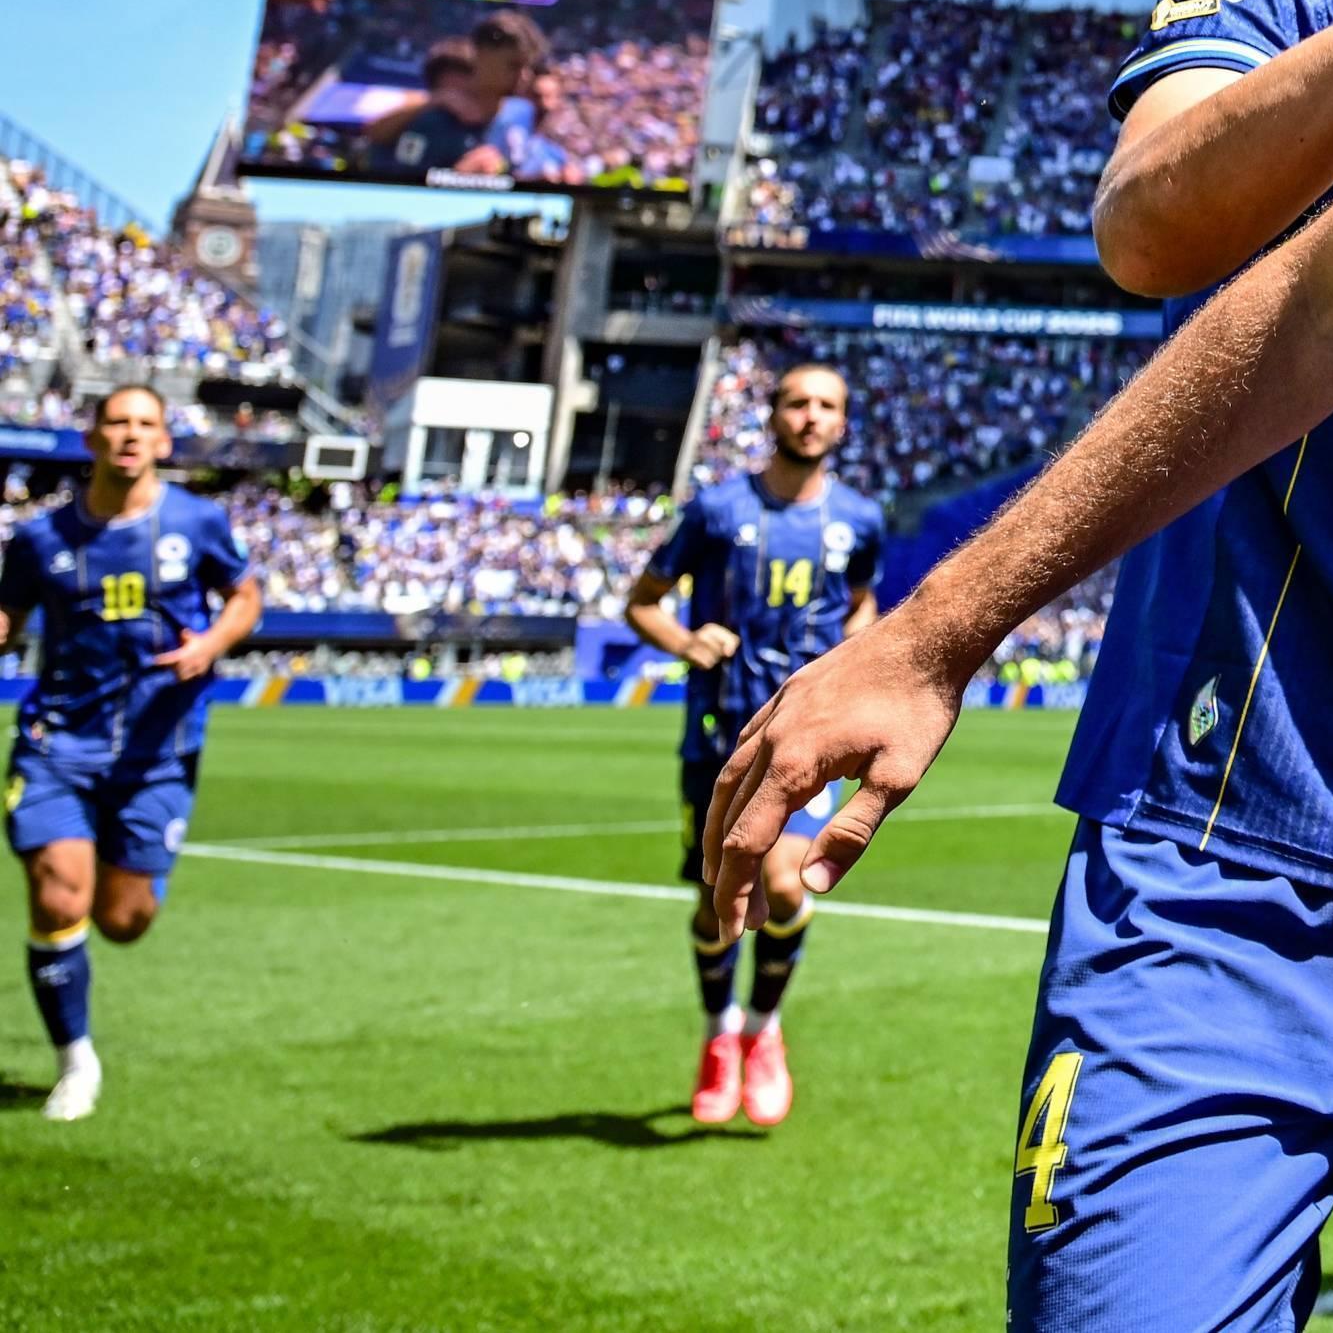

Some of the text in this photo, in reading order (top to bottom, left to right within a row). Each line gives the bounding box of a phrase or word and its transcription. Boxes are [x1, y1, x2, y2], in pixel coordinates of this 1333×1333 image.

[873, 303, 922, 329] FIFA
[922, 305, 1000, 332] WORLD
[1001, 307, 1044, 334] CUP
[766, 558, 813, 608] 14
[1015, 1051, 1084, 1234] 4
